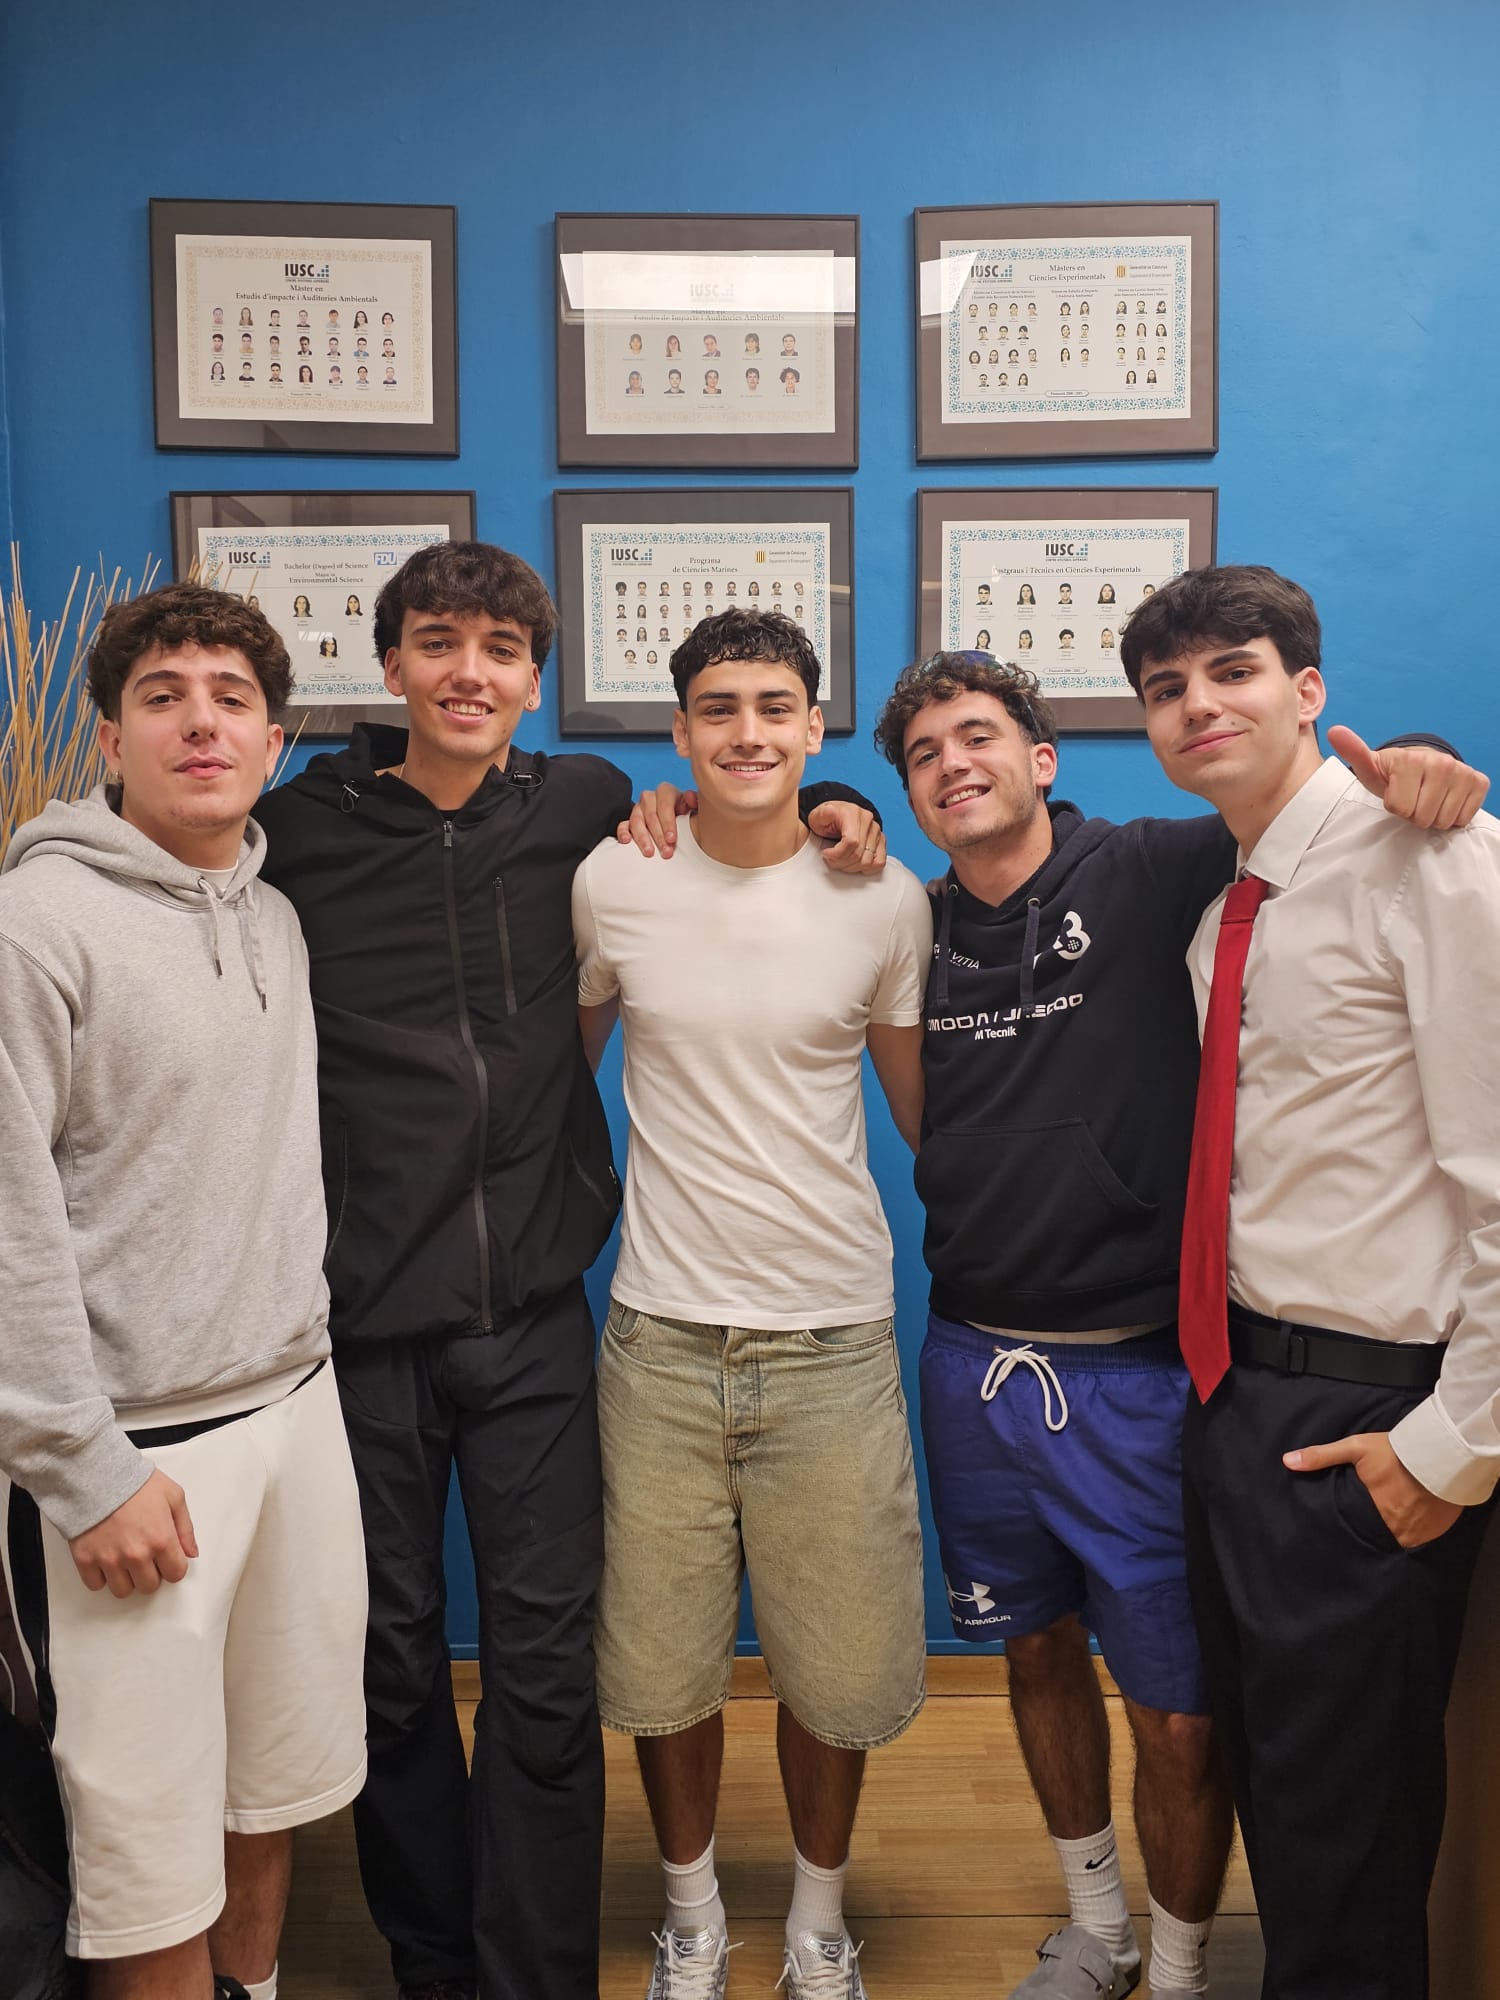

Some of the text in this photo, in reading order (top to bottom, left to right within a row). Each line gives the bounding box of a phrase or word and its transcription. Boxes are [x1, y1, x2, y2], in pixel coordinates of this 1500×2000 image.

[284, 263, 315, 277] IUSC
[970, 264, 999, 278] IUSC
[1058, 273, 1106, 282] Experimentals
[690, 283, 719, 297] IUSC
[236, 292, 260, 300] Estudis
[338, 295, 379, 303] Ambientals
[611, 548, 639, 561] IUSC
[1045, 543, 1074, 556] IUSC
[229, 551, 257, 564] IUSC
[689, 557, 721, 565] Programa
[284, 562, 311, 570] Bachelor
[1094, 566, 1141, 574] Experimentals
[289, 576, 338, 584] Environmental
[985, 1025, 1017, 1040] Tecnik
[964, 1614, 1011, 1626] ARMOUR
